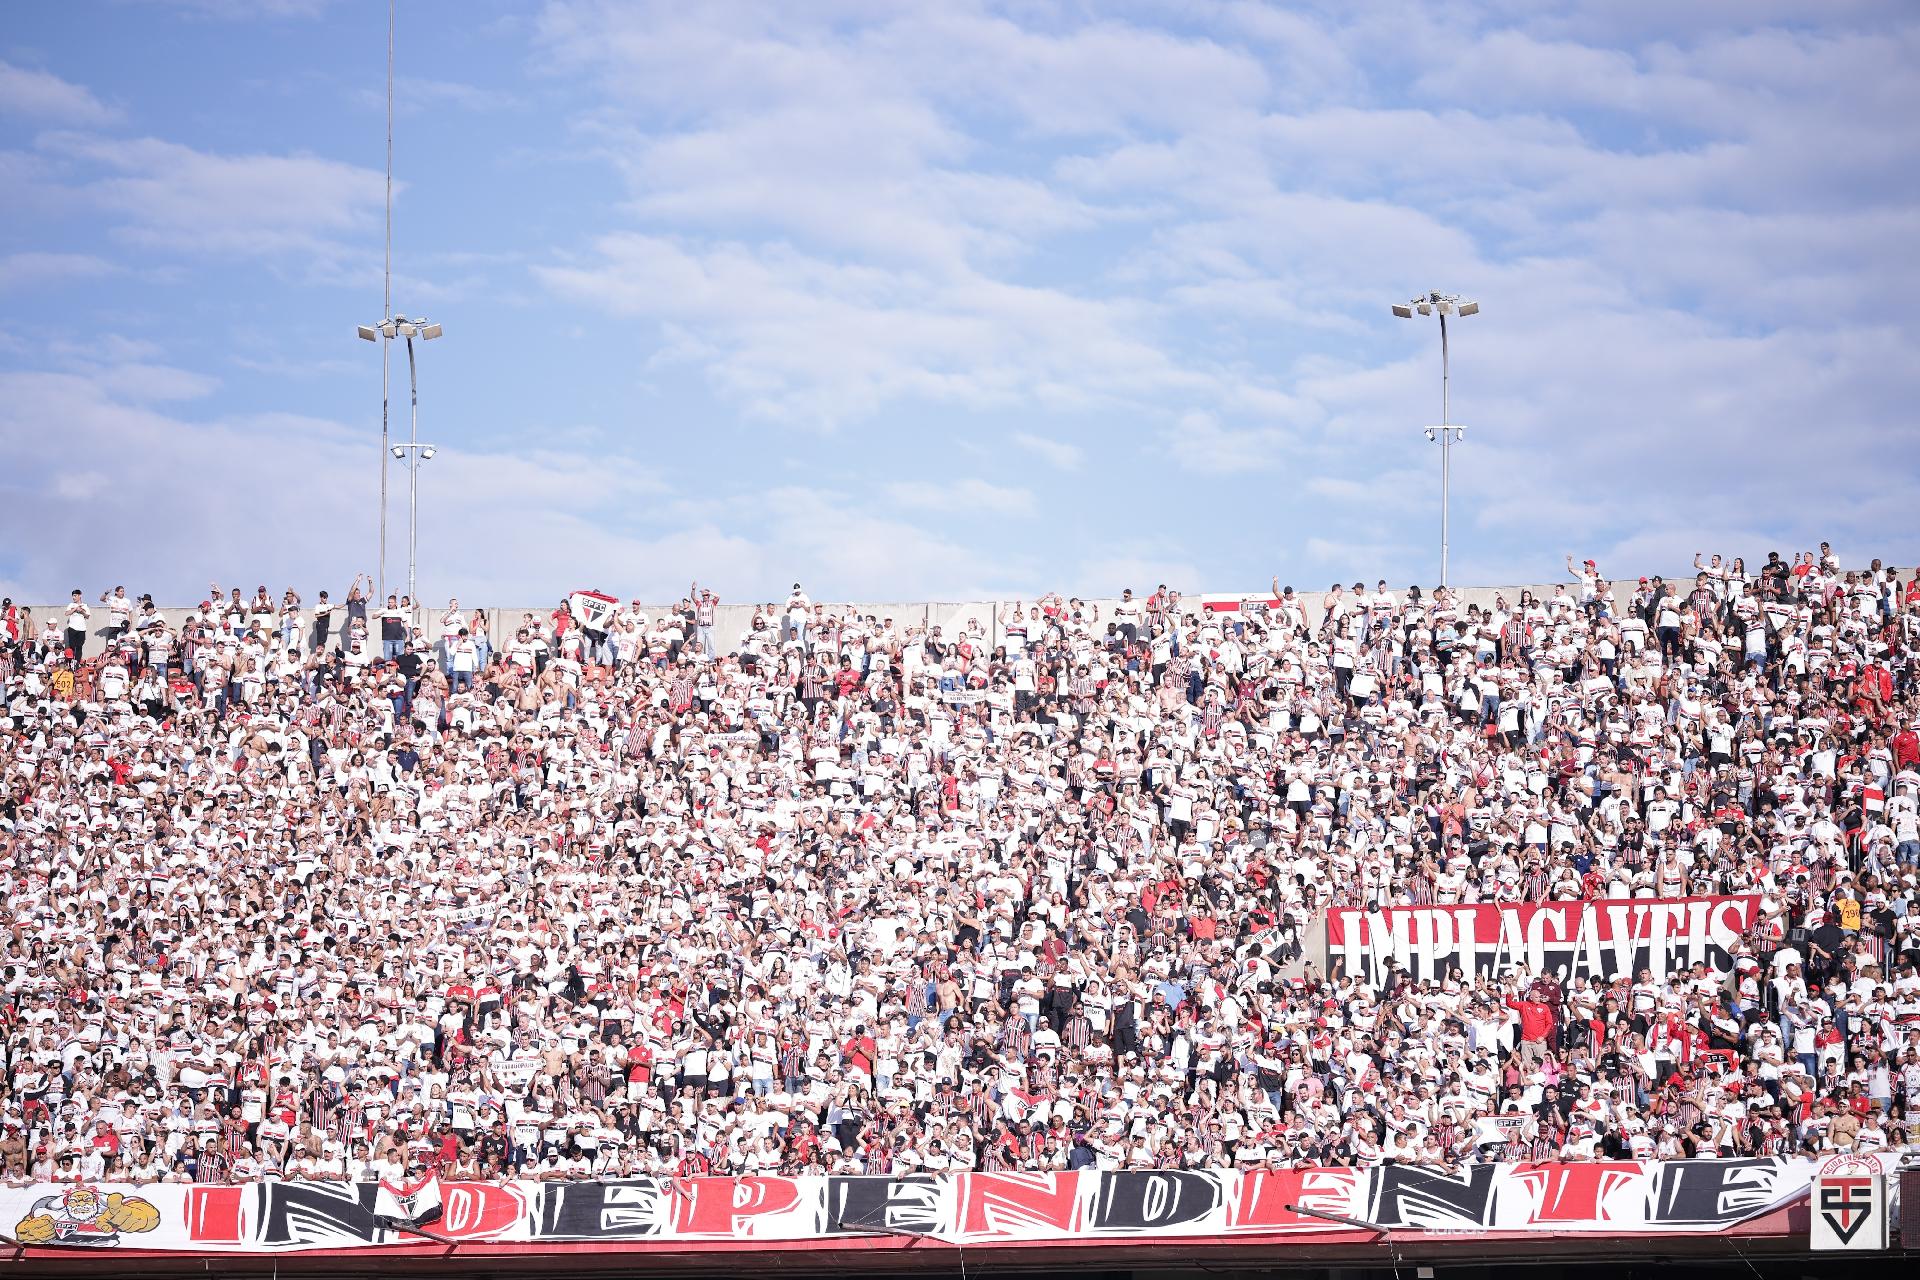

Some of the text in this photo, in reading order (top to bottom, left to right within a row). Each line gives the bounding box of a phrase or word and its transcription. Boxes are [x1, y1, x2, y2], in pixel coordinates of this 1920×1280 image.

[583, 598, 606, 612] SPFC
[56, 680, 71, 688] 502
[1497, 1119, 1522, 1127] SPFC
[185, 1157, 1779, 1246] INDEPENDENTE
